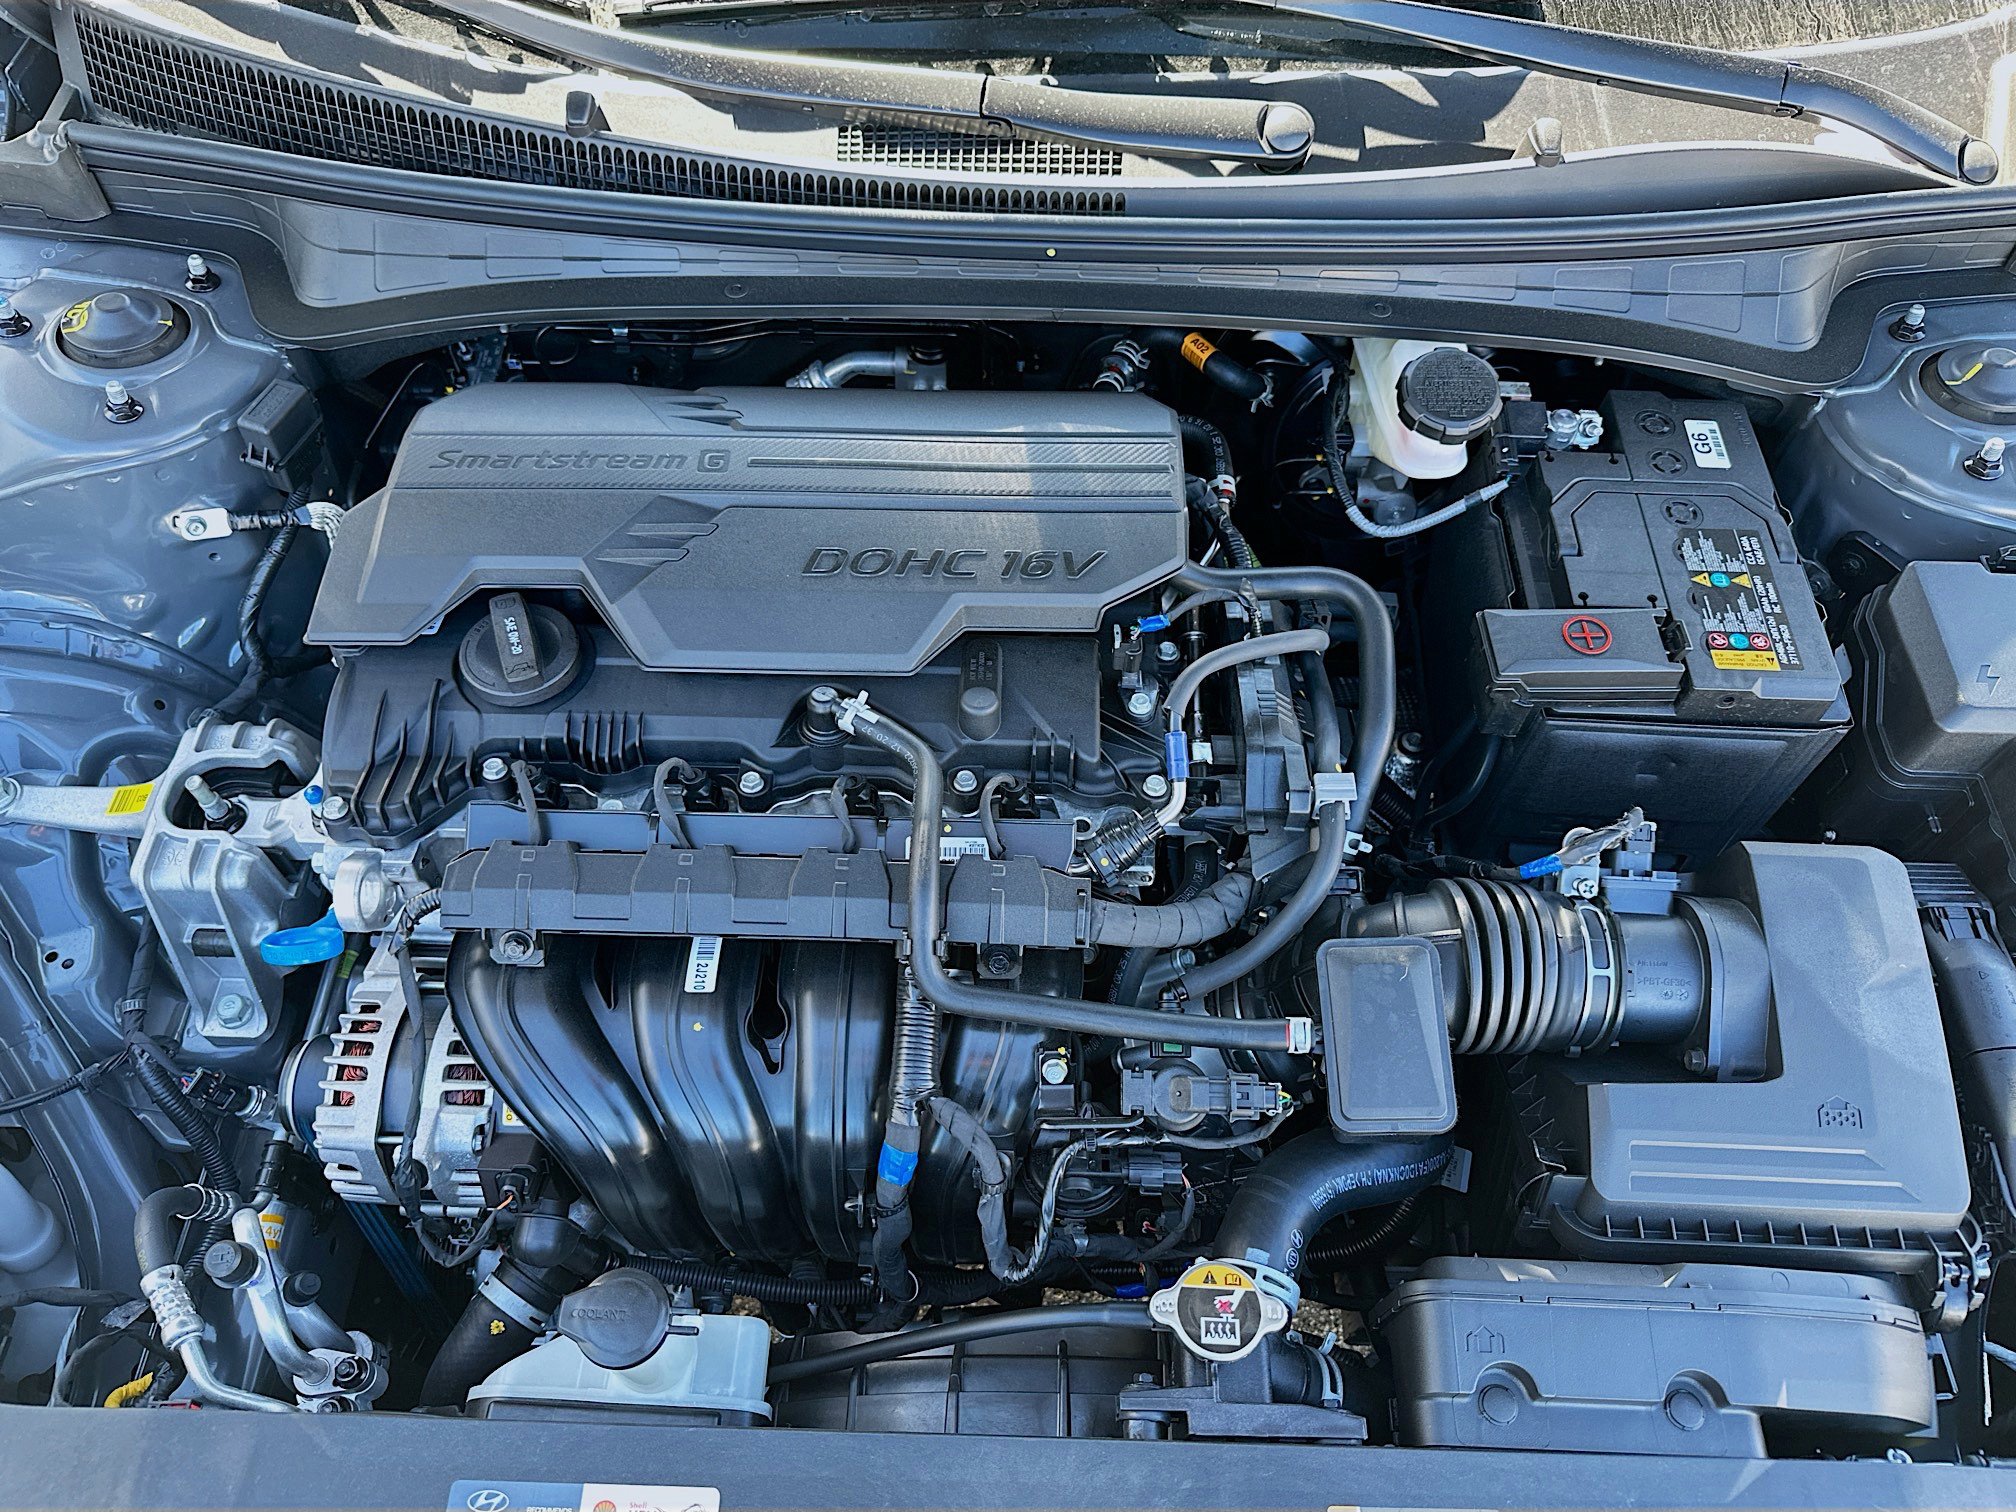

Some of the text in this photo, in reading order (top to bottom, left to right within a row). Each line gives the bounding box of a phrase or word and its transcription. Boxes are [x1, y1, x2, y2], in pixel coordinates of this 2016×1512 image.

[1190, 338, 1209, 354] A02
[1691, 433, 1712, 454] G6
[428, 449, 690, 470] Smartstream
[801, 547, 1108, 579] DOHC 16V
[1744, 551, 1757, 565] CCA
[1771, 604, 1783, 614] RC
[503, 616, 518, 632] SAE
[693, 962, 709, 991] 2J210
[571, 1308, 626, 1320] COOLANT
[629, 1501, 648, 1509] Shell
